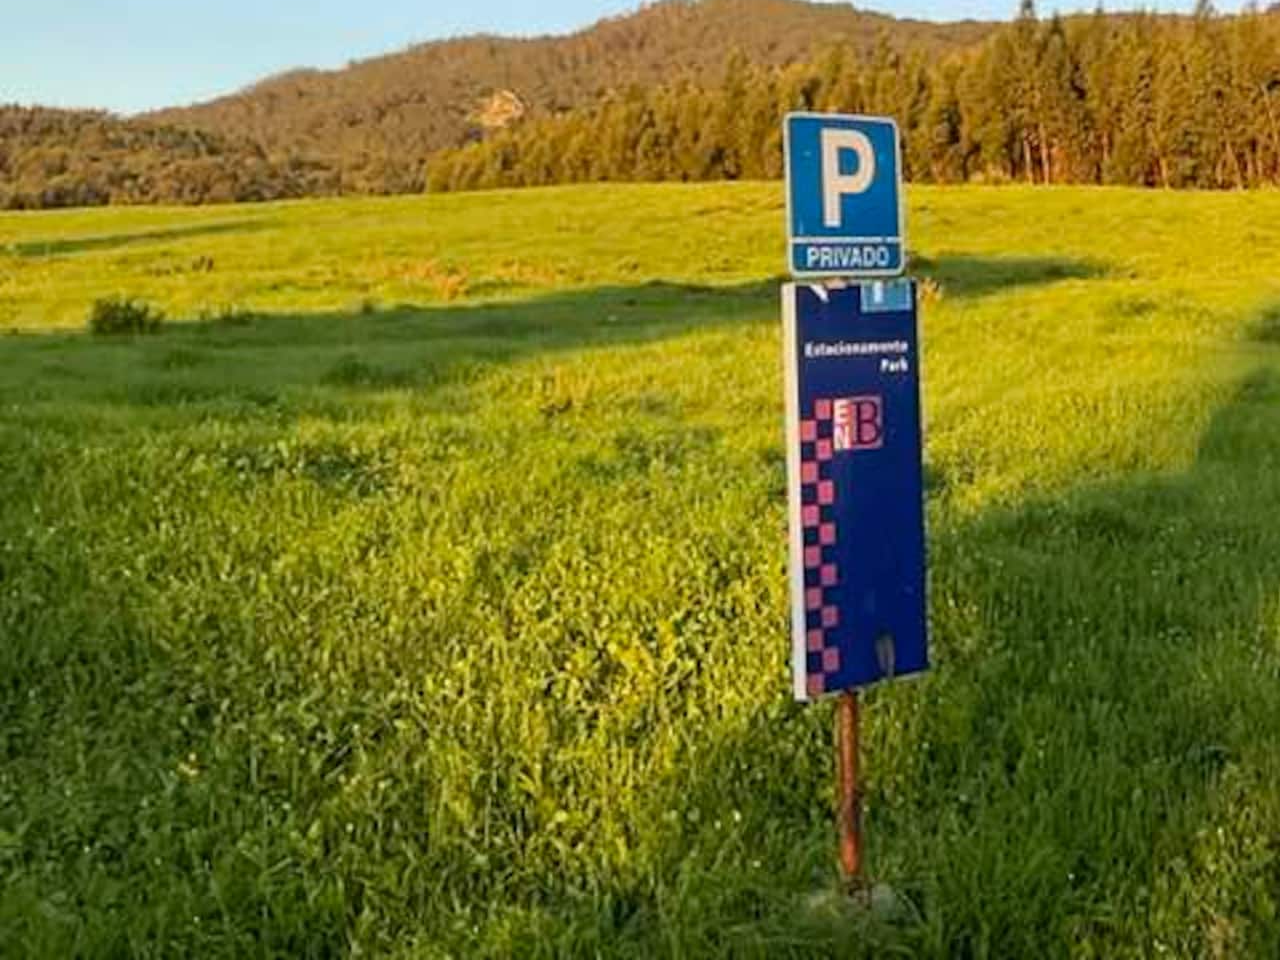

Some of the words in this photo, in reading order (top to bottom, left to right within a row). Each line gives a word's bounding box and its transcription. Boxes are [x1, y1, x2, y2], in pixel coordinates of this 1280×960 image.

[821, 128, 876, 228] P
[806, 246, 890, 269] PRIVADO
[804, 340, 909, 358] Estacionamento
[880, 356, 909, 373] Park
